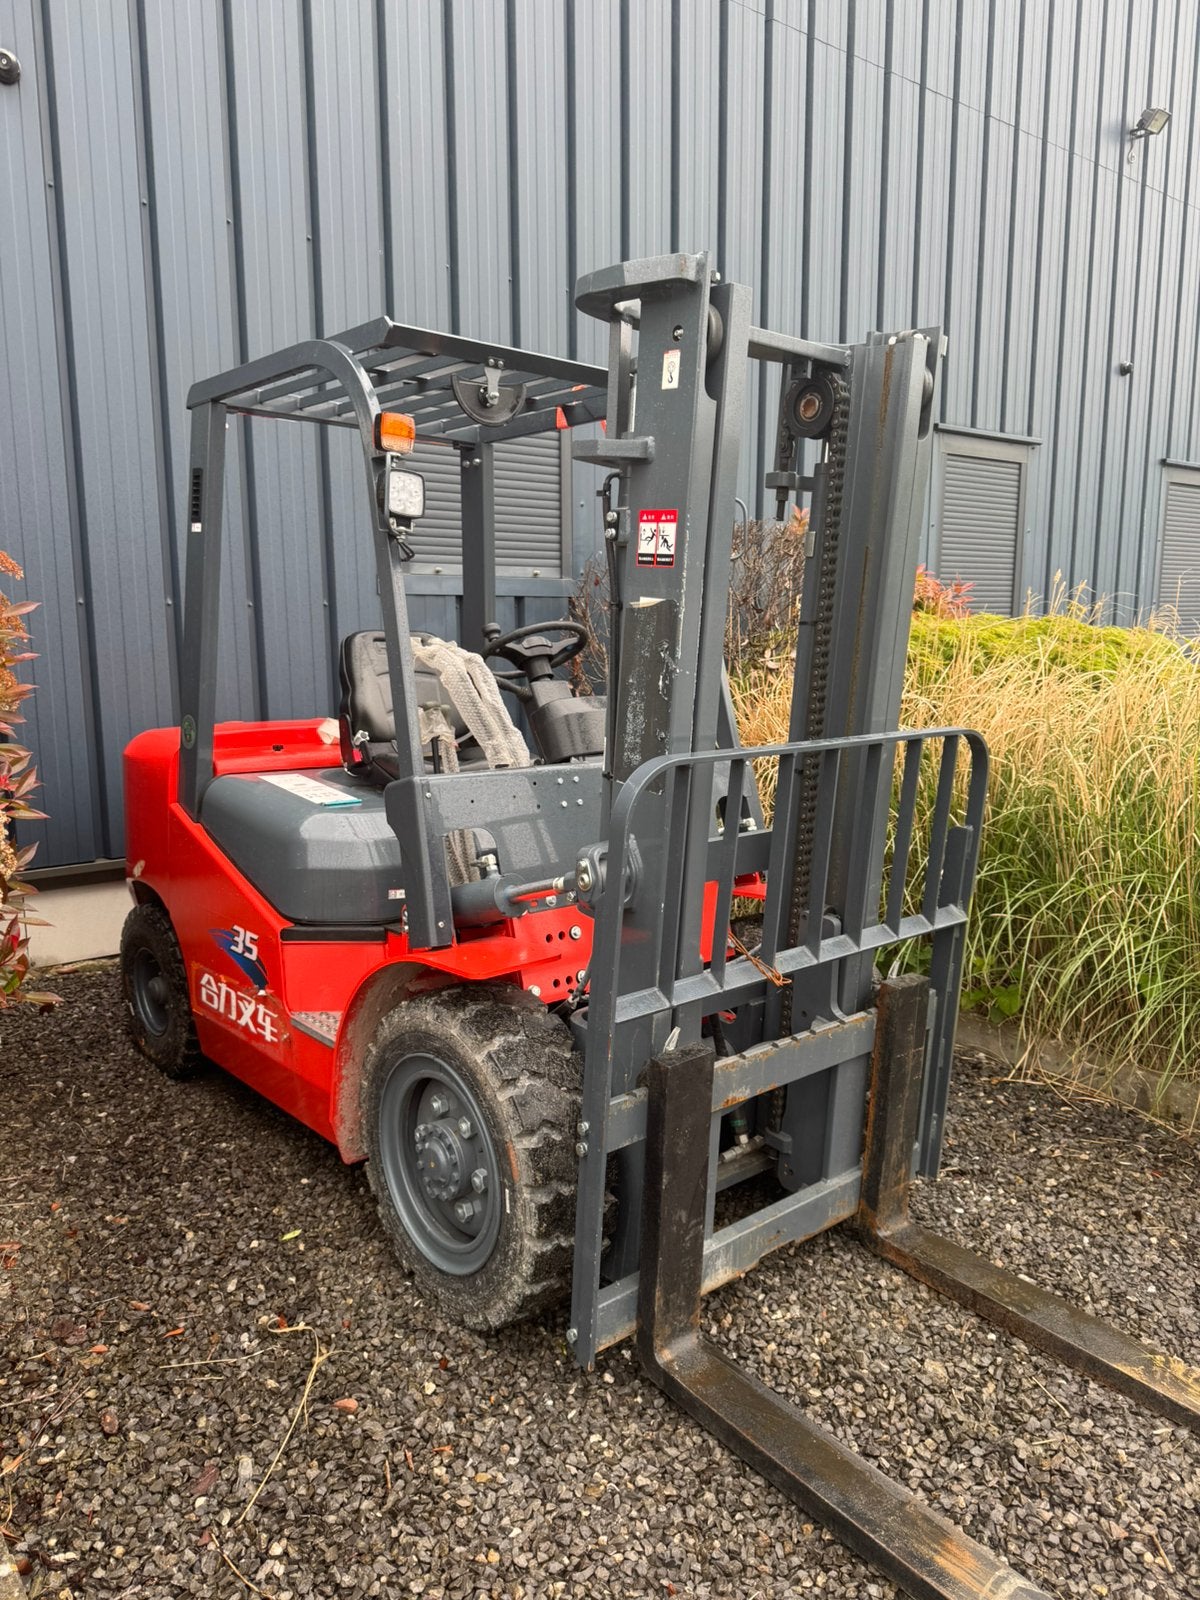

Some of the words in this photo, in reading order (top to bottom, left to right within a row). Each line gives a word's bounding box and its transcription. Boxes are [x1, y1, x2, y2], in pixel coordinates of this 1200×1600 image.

[230, 925, 259, 961] 35
[200, 973, 279, 1042] 合力叉车
